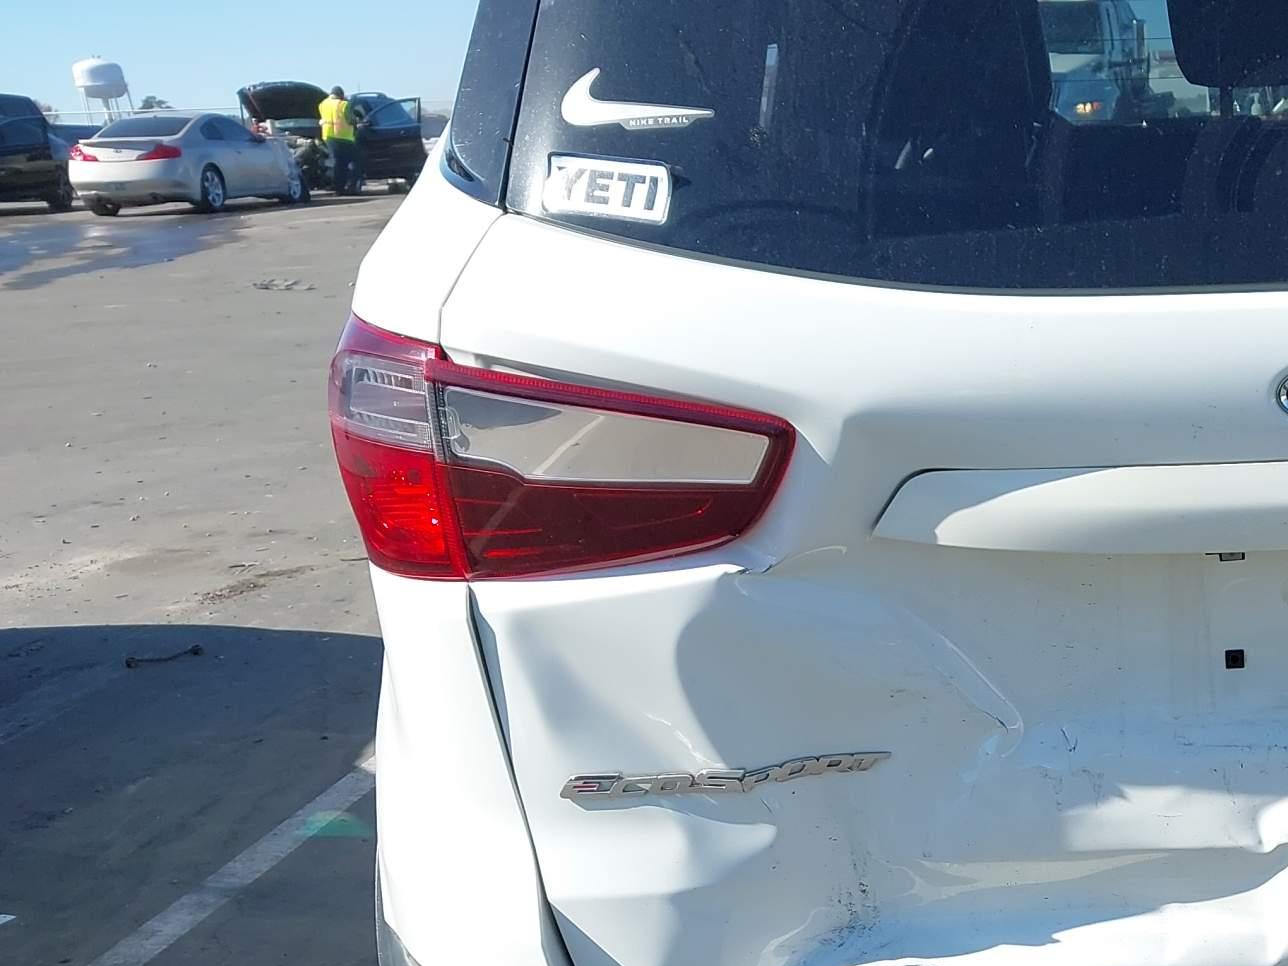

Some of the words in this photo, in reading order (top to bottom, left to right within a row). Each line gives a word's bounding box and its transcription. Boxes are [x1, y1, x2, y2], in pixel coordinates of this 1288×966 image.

[629, 118, 654, 127] NIKE
[657, 116, 689, 124] TRAIL
[556, 165, 659, 211] YETI
